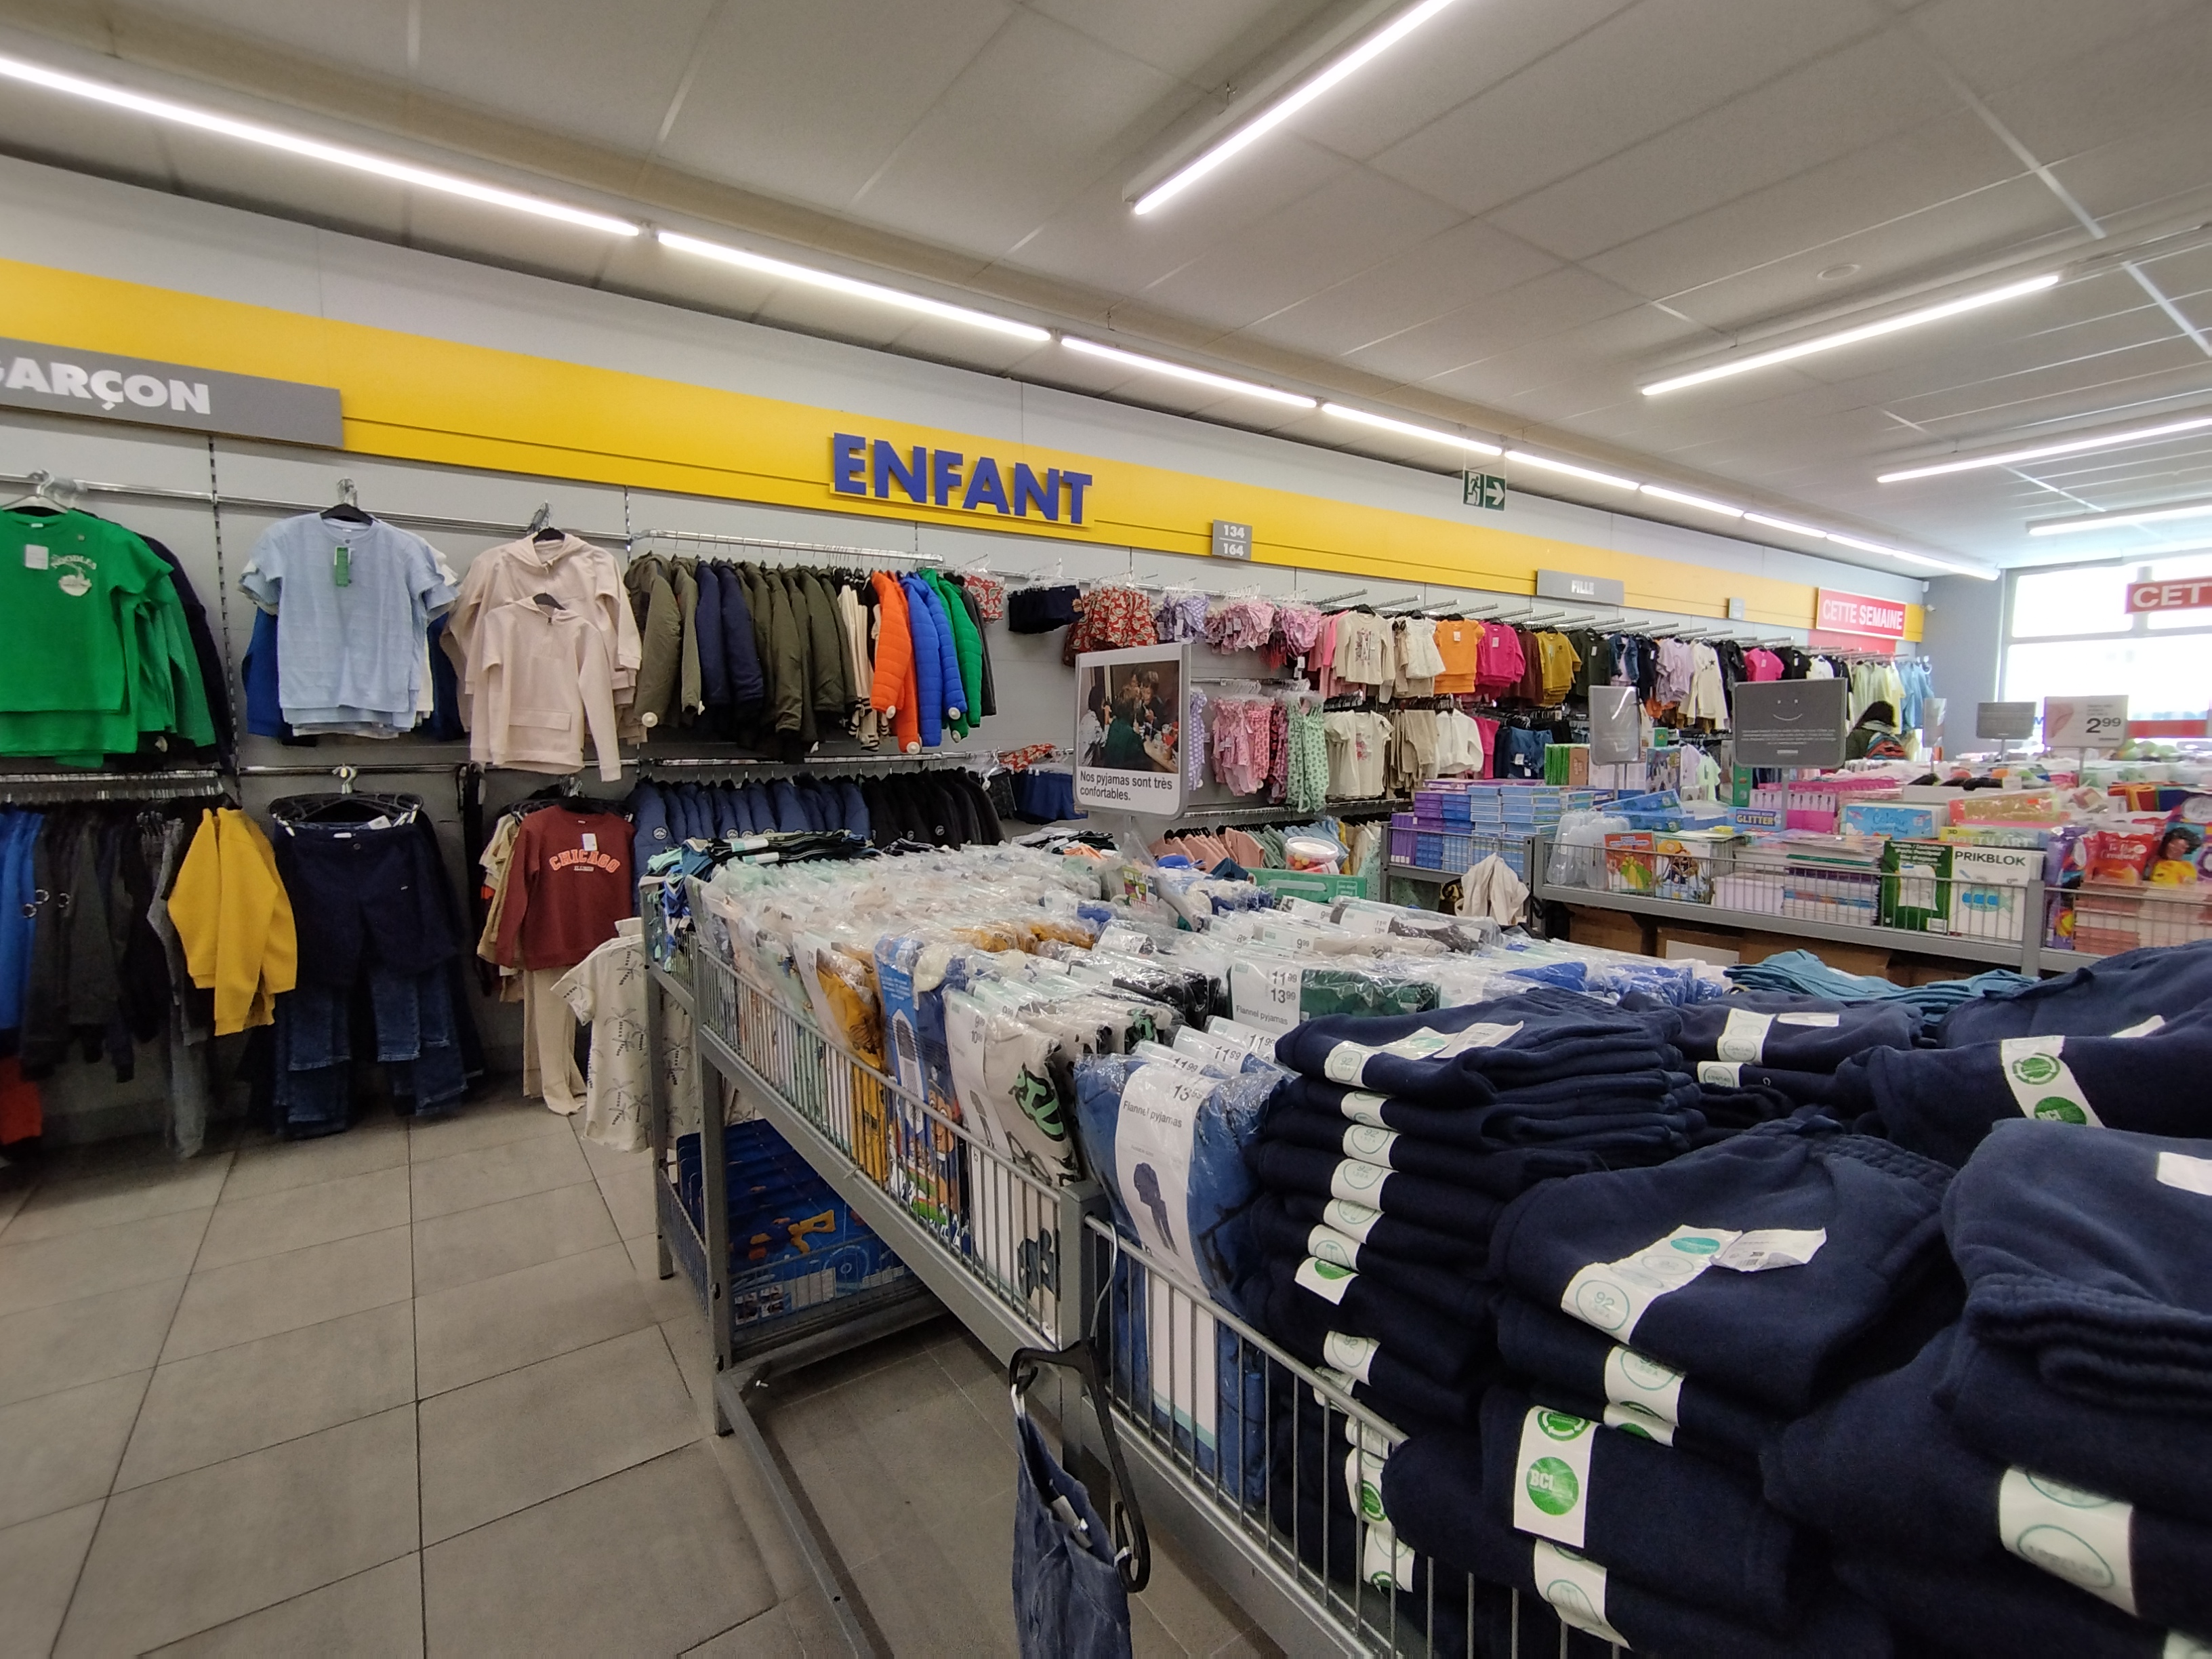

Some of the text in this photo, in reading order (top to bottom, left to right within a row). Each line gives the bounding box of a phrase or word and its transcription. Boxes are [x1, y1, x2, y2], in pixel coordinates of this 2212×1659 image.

[0, 357, 211, 414] ARÇON
[834, 432, 1092, 525] ENFANT
[1224, 525, 1245, 539] 134
[1223, 543, 1244, 556] 164
[1571, 579, 1595, 596] FILLE
[2133, 581, 2212, 608] CET
[1823, 599, 1904, 630] CETTE SEMAINE
[1080, 771, 1172, 790] Nos pyjamas sont très
[1080, 786, 1131, 801] confortables.
[1737, 815, 1774, 825] GLITTER
[549, 848, 621, 873] CHICAGO
[1954, 851, 2026, 866] PRIKBLOK
[1235, 1005, 1288, 1025] Flannel pyjamas
[1340, 1057, 1353, 1066] 92
[1123, 1100, 1183, 1128] Flannel pyjamas
[1364, 1128, 1379, 1139] 92
[1357, 1165, 1372, 1174] 92
[1595, 1291, 1615, 1311] 92
[1530, 1469, 1554, 1490] BCI
